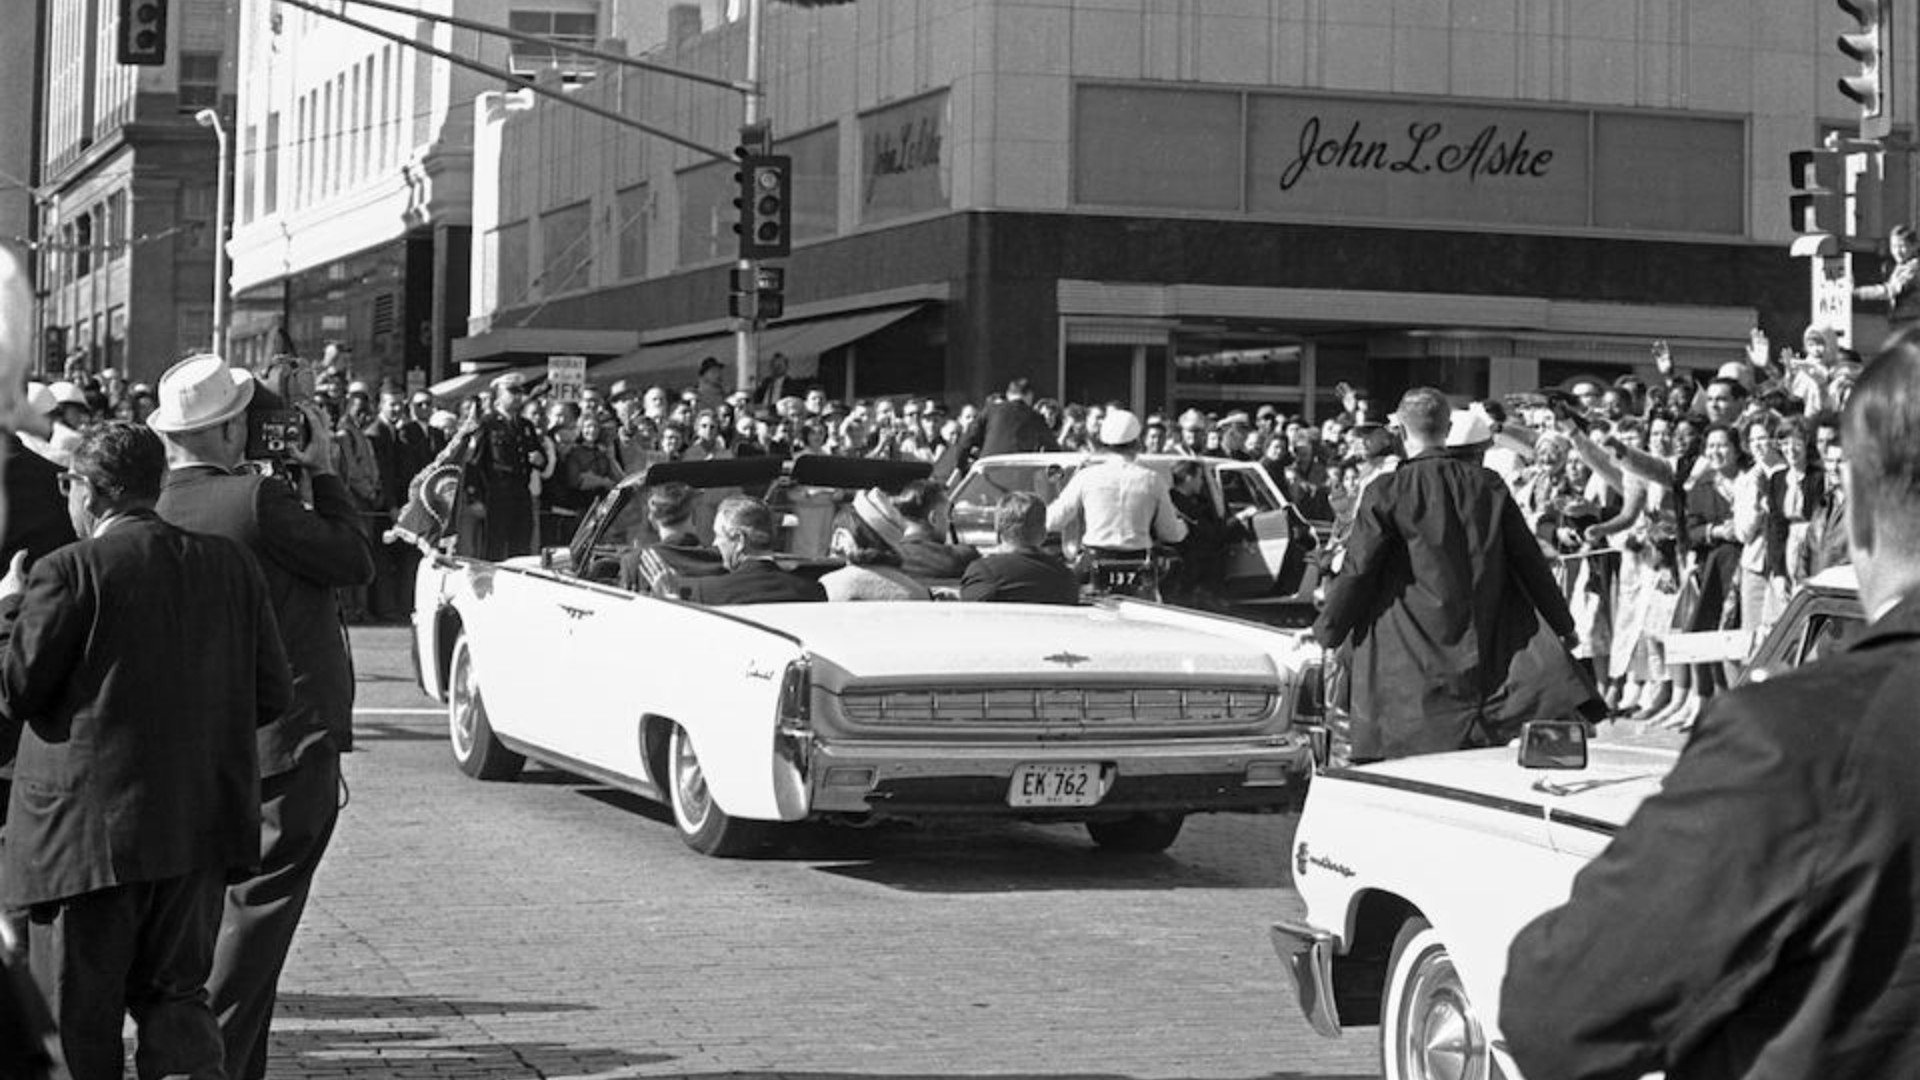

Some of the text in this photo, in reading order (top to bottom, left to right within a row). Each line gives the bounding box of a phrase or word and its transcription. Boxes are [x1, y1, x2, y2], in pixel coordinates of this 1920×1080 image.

[1279, 115, 1554, 191] John L. Ashe
[549, 383, 582, 399] JFK
[1023, 772, 1088, 796] EK 762
